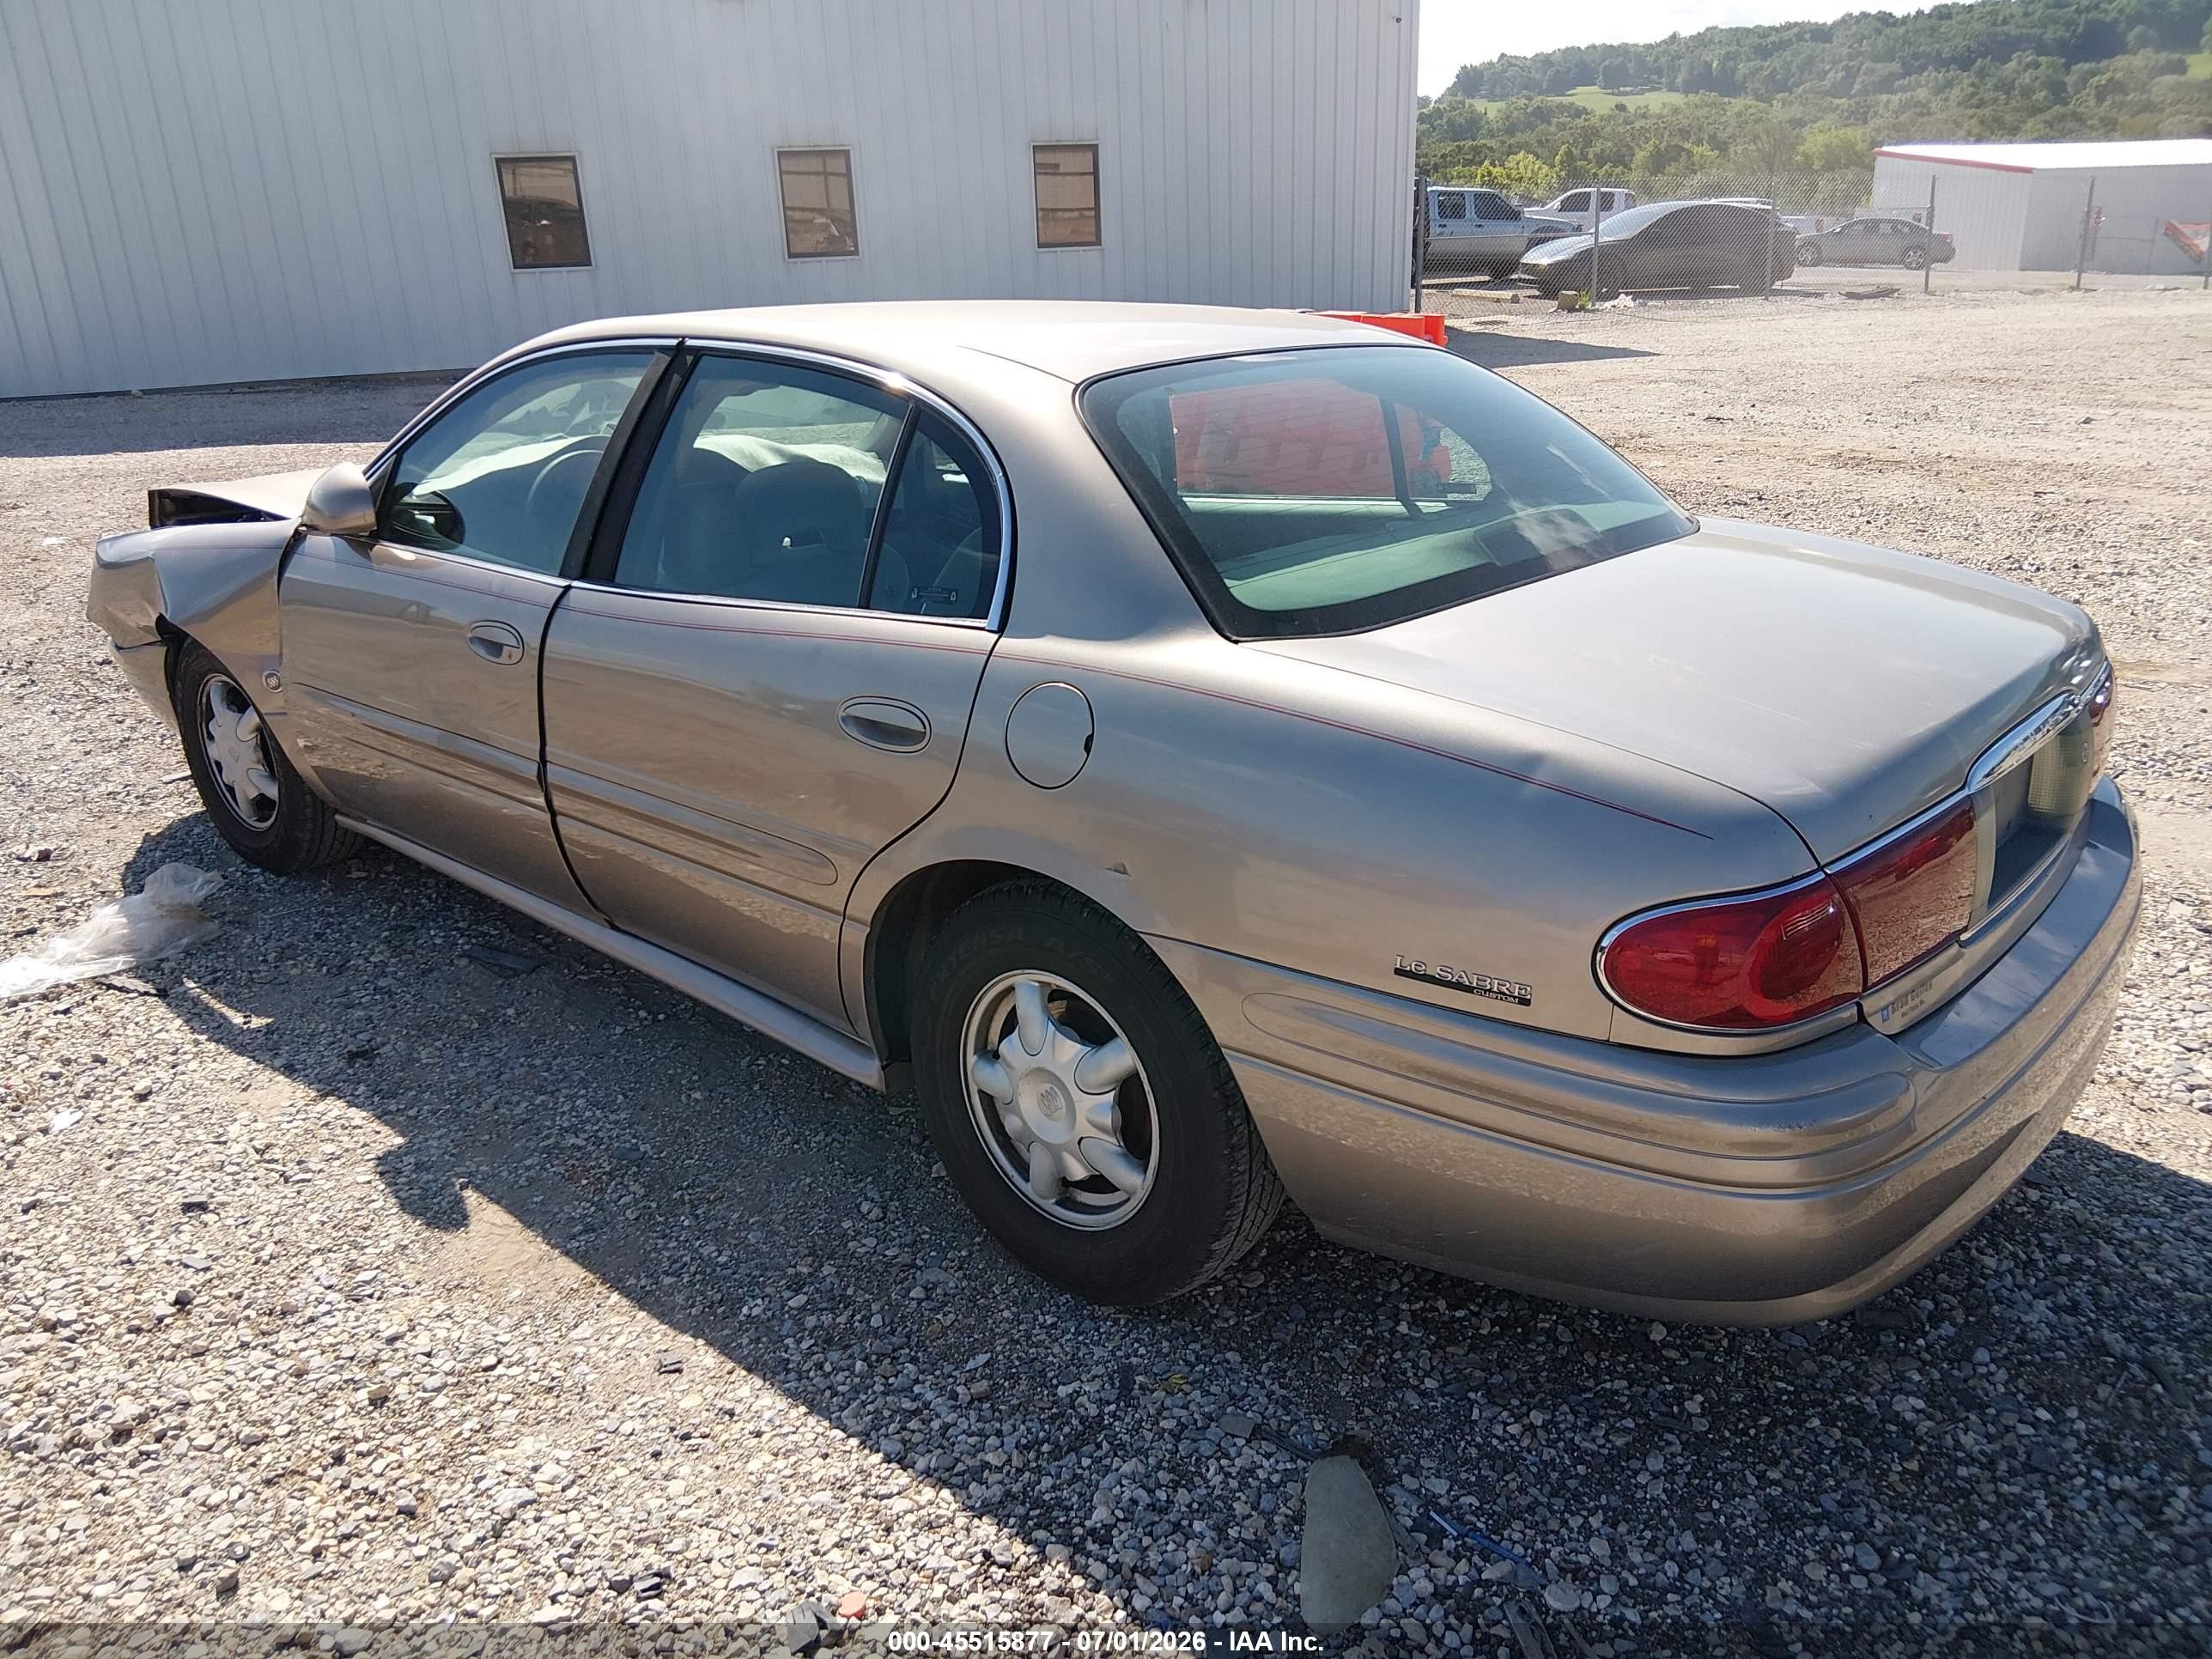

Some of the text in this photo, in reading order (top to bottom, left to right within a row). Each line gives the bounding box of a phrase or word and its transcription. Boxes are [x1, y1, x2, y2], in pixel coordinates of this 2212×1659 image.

[1394, 954, 1533, 999] Le SABRE
[1473, 988, 1519, 1005] CUSTOM
